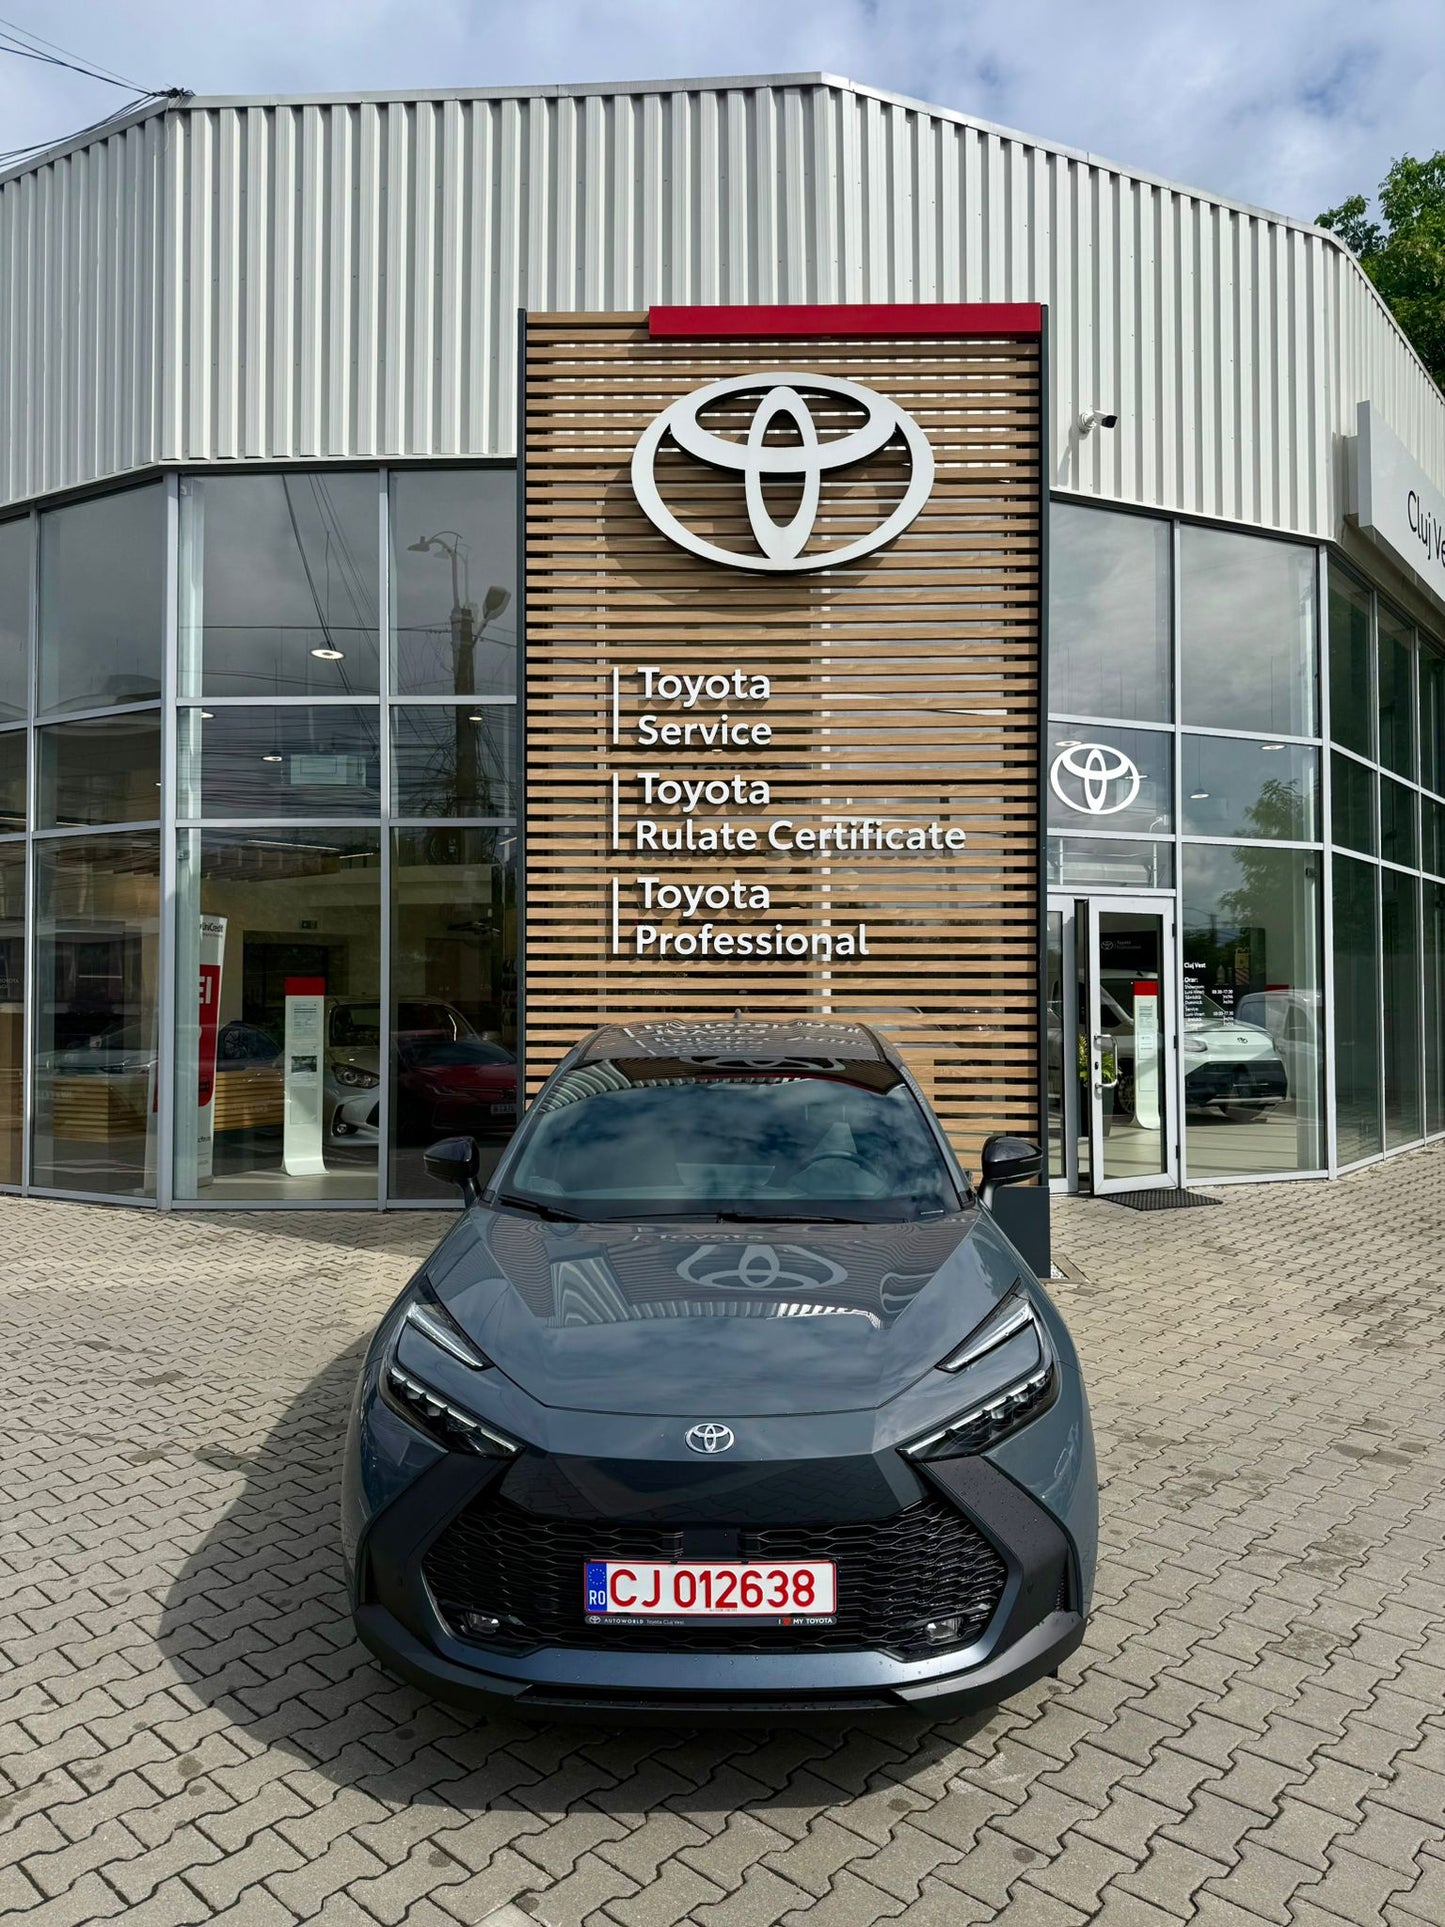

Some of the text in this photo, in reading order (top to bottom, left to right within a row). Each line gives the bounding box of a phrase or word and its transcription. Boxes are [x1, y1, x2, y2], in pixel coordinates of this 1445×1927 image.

[1407, 490, 1431, 560] Cluj
[637, 666, 771, 708] Toyota
[637, 714, 772, 746] Service
[637, 772, 771, 813] Toyota
[636, 819, 967, 851] Rulate Certificate
[637, 876, 771, 917] Toyota
[636, 923, 870, 956] Professional
[1184, 962, 1194, 970] Cluj
[588, 1568, 816, 1609] RO CJ 012638
